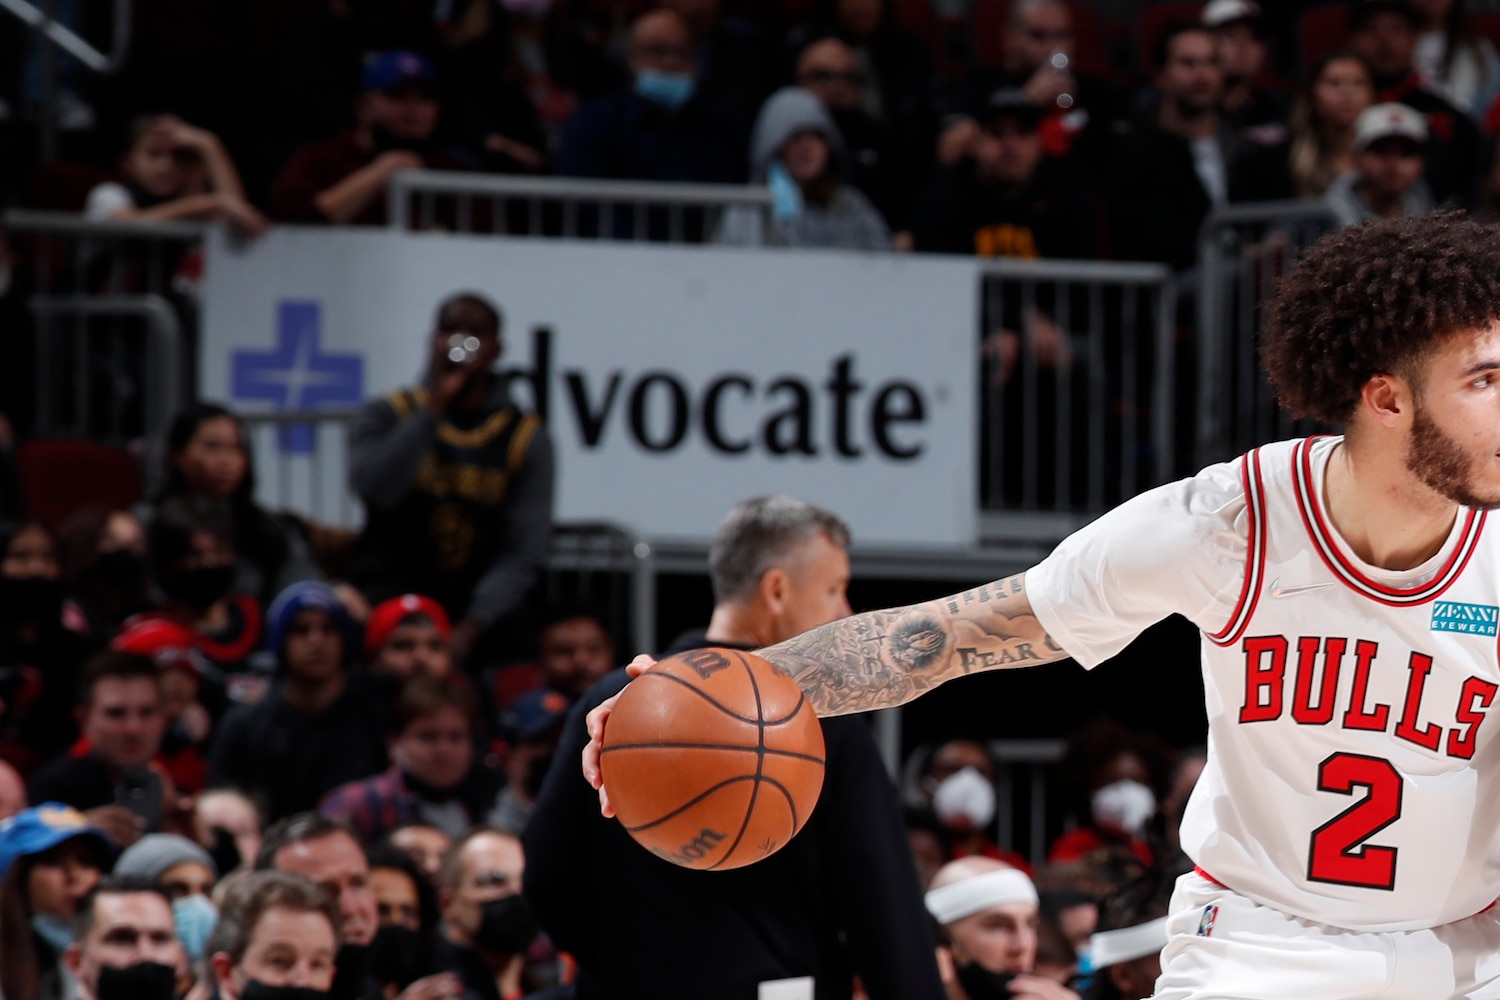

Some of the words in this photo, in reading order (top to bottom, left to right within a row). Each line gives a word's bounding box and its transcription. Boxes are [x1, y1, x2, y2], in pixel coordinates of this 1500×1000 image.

[504, 324, 929, 463] dvocate
[1431, 620, 1496, 634] EYEWEAR
[1433, 602, 1498, 622] ZENNI
[956, 642, 1044, 674] FEAR
[1238, 634, 1499, 760] BULLS
[1306, 751, 1403, 891] 2
